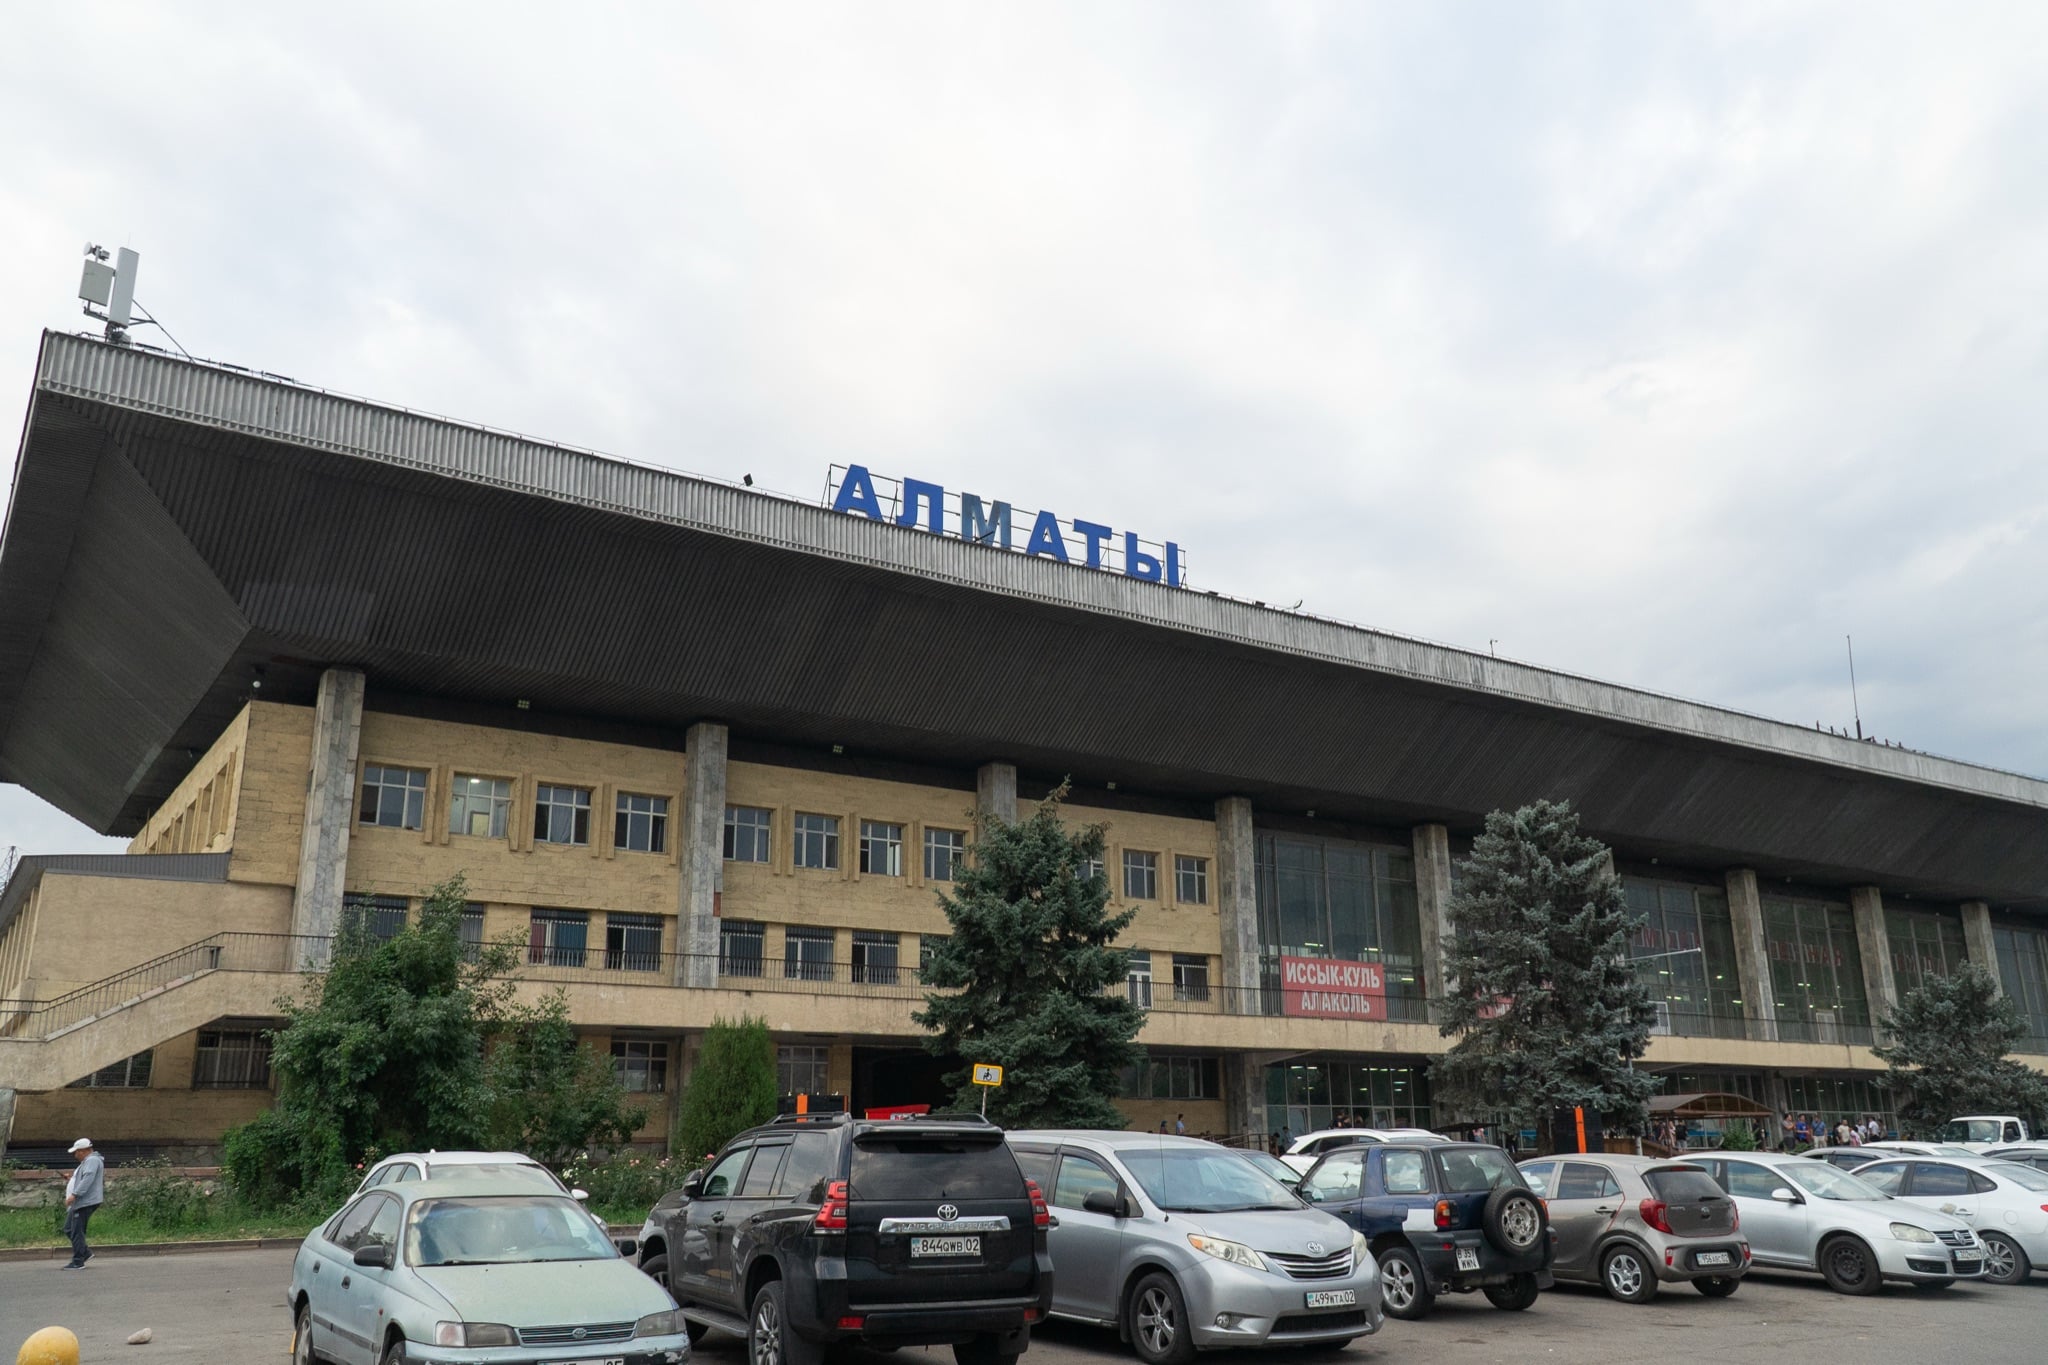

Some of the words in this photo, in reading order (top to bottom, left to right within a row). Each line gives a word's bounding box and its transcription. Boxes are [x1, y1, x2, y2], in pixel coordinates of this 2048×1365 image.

[832, 463, 1180, 588] АЛМАТЫ
[1286, 961, 1380, 988] ИССЫК-КУЛЬ
[1301, 991, 1370, 1014] АЛАКОЛЬ
[922, 1239, 963, 1253] 844QWB
[965, 1238, 979, 1252] 02
[1344, 1291, 1354, 1302] 02
